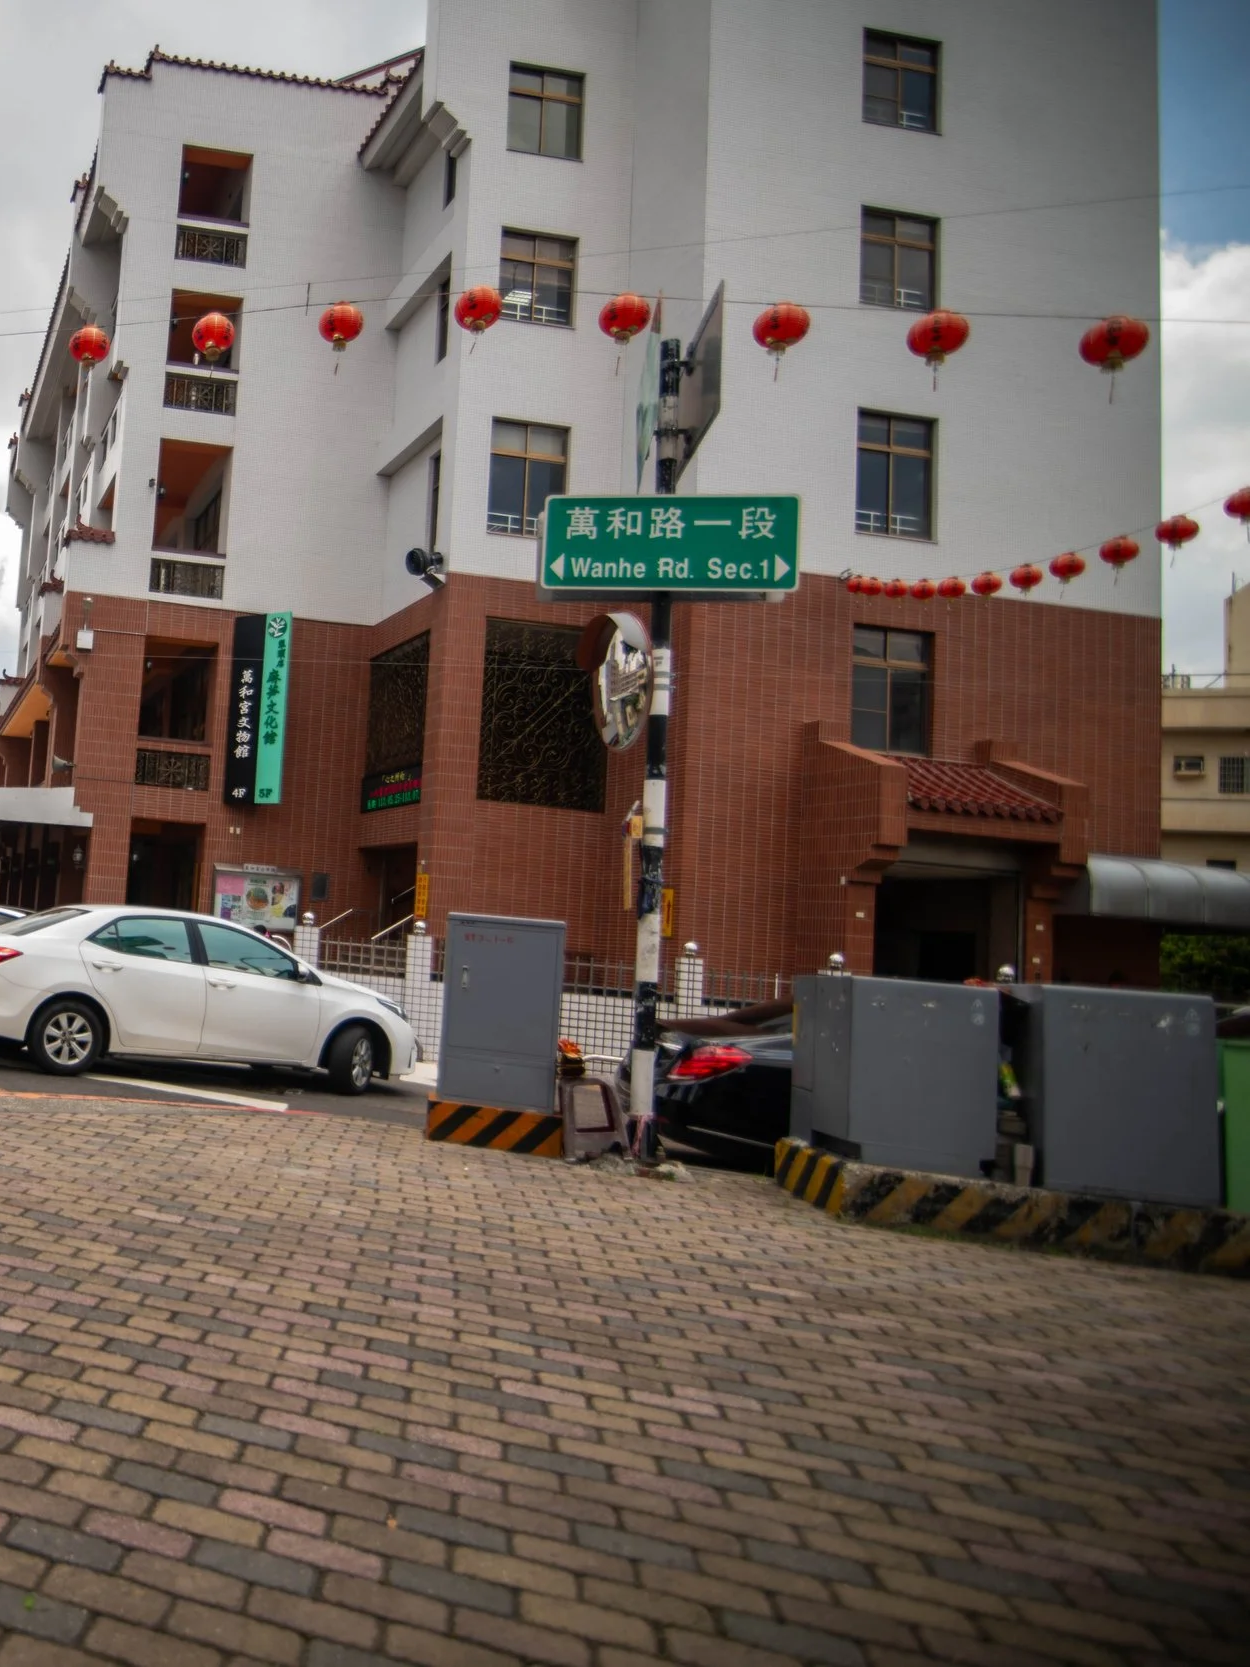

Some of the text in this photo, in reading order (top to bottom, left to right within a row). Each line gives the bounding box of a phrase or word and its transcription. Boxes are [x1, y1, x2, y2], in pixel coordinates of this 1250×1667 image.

[565, 506, 777, 540] 萬和路一段
[571, 556, 769, 580] Wanhe Rd. Sec.1
[234, 669, 254, 759] 萬和宮文物館
[232, 788, 247, 799] 4F
[259, 788, 273, 798] 5F
